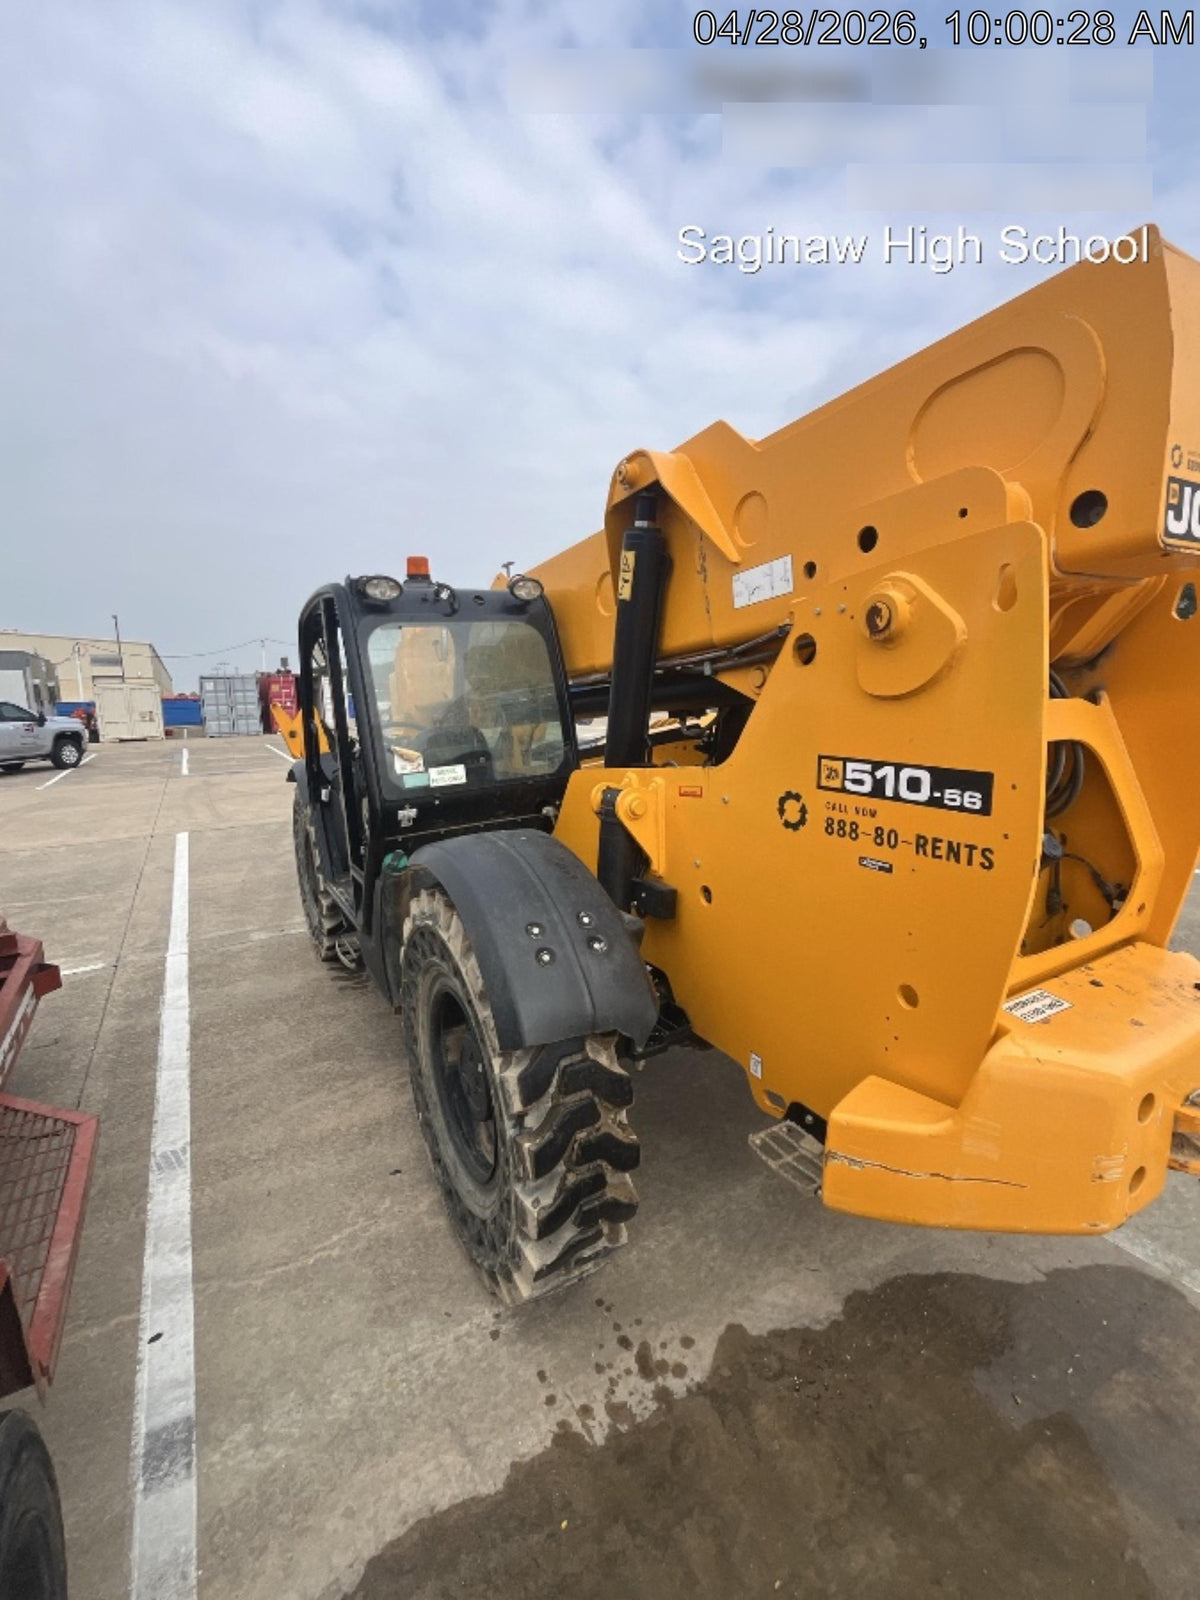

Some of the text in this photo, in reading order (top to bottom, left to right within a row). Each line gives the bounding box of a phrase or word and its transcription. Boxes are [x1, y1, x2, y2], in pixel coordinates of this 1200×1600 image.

[824, 800, 878, 819] CALL NOW
[824, 816, 995, 871] 888-80-RENTS
